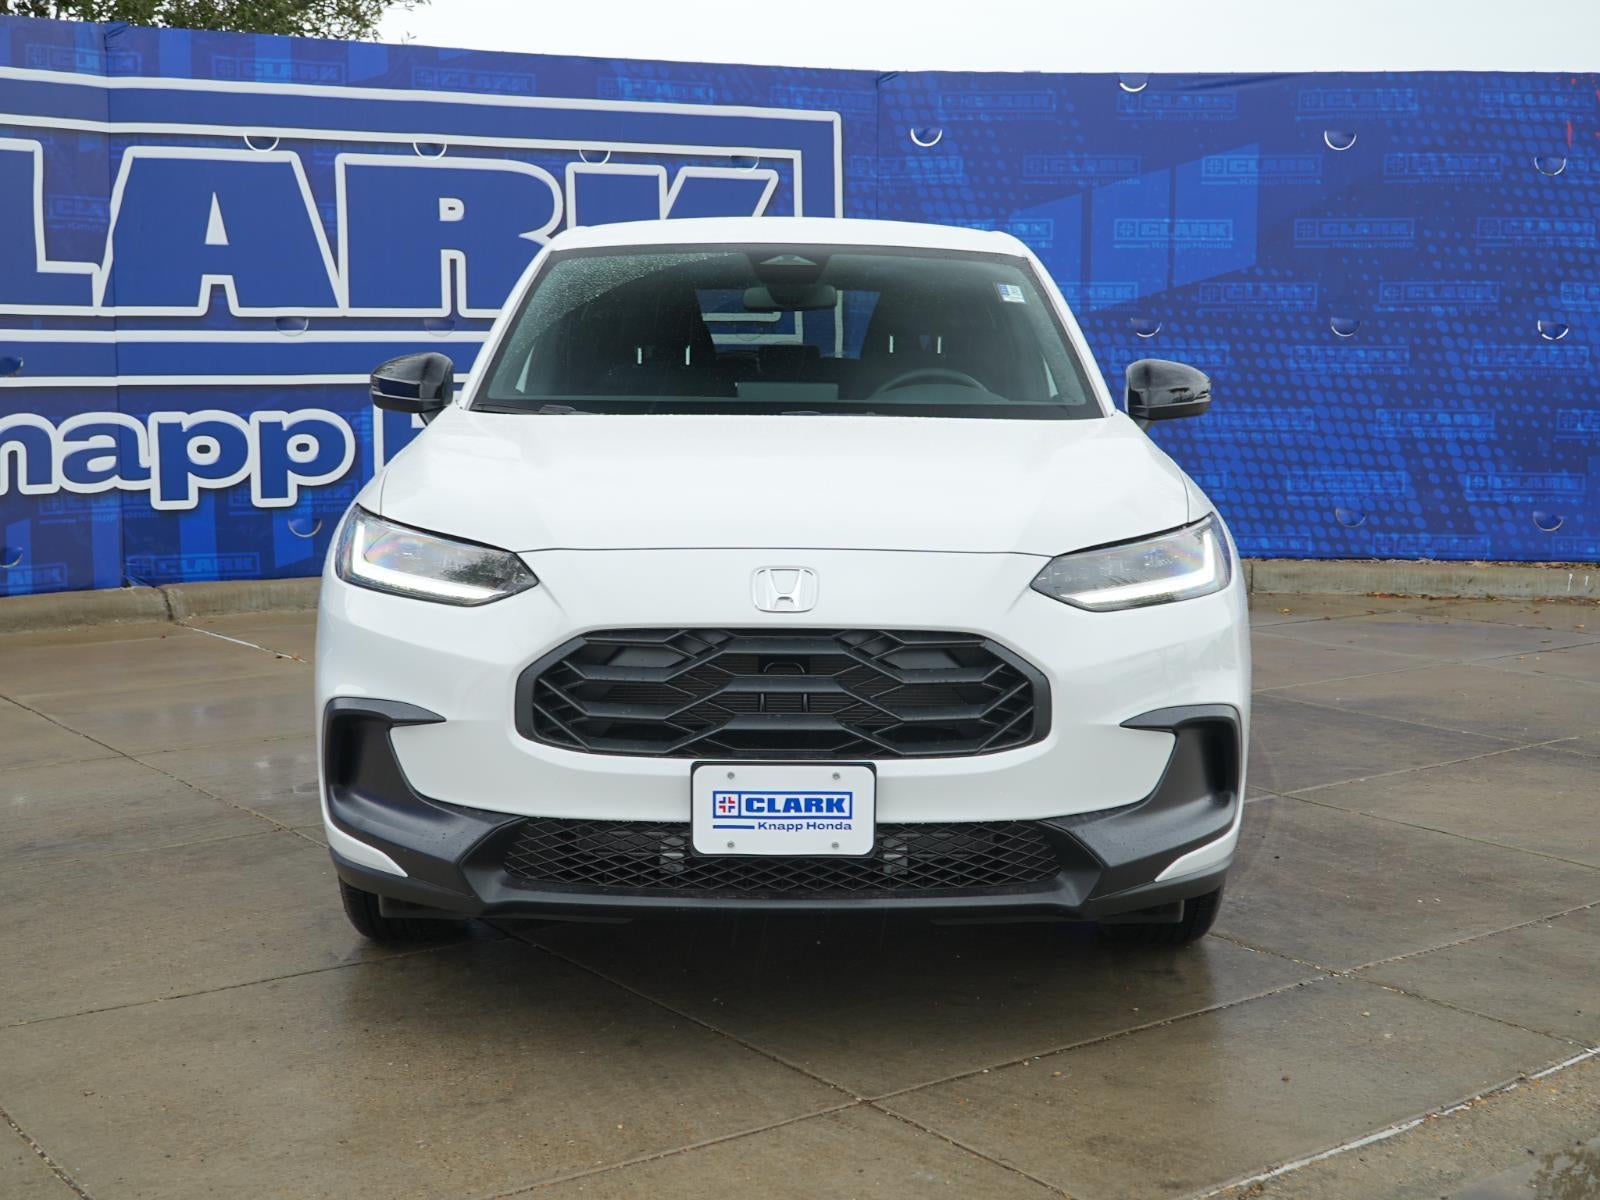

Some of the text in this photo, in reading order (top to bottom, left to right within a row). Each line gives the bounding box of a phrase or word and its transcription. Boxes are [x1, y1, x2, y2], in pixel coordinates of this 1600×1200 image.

[1141, 223, 1228, 237] CLARK
[745, 797, 847, 813] CLARK
[757, 821, 852, 832] Knapp Honda
